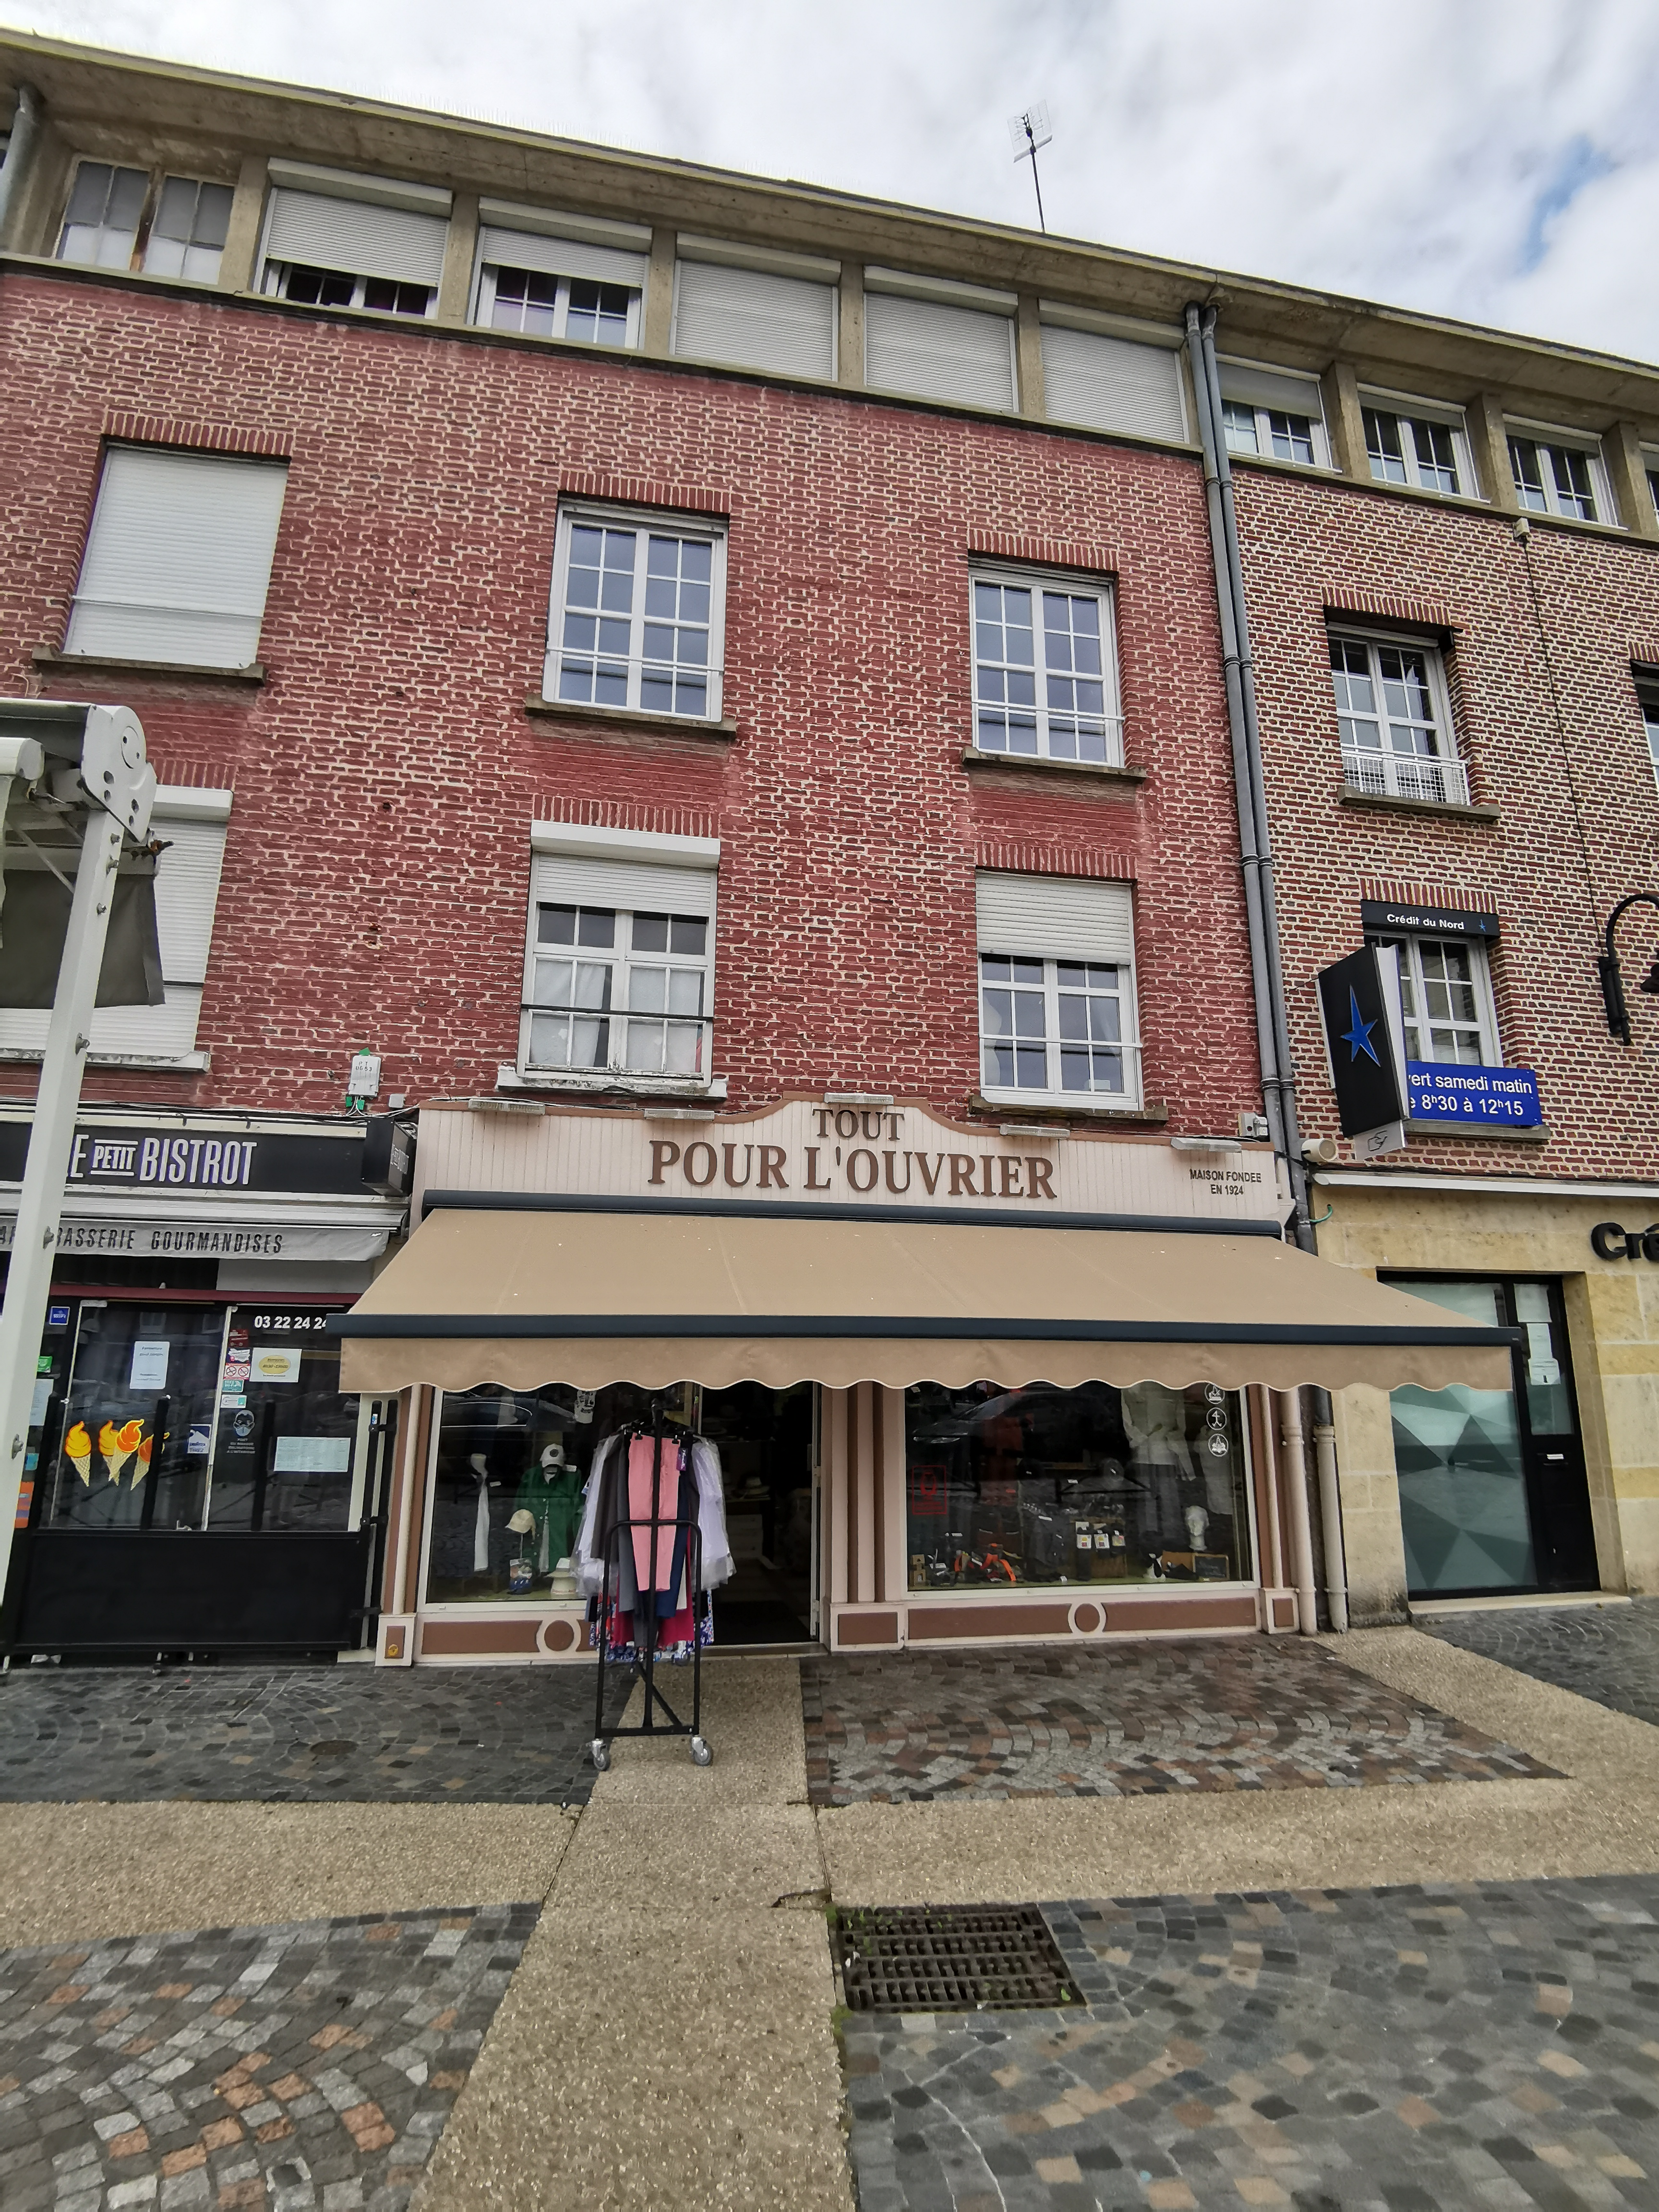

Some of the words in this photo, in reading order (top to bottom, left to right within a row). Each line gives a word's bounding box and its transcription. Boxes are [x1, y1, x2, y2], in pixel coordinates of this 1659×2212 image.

[1387, 914, 1420, 925] Crédit
[1423, 918, 1436, 927] du
[1439, 919, 1465, 930] Nord
[1408, 1072, 1432, 1087] ert
[1435, 1076, 1489, 1091] samedi
[1492, 1079, 1533, 1094] matin
[1421, 1094, 1457, 1112] 8h30
[1463, 1097, 1474, 1113] à
[1479, 1098, 1524, 1116] 12h15
[812, 1108, 905, 1141] TOUT
[70, 1134, 90, 1178] E
[92, 1145, 136, 1170] PETIT
[139, 1137, 257, 1185] BISTROT
[647, 1140, 789, 1188] POUR
[803, 1146, 1058, 1199] L'OUVRIER
[1189, 1168, 1224, 1181] MAISON
[1226, 1171, 1262, 1183] FONDEE
[1210, 1184, 1222, 1195] EN
[1225, 1185, 1244, 1195] 1924
[151, 1231, 283, 1254] GOURMANDISES
[254, 1315, 271, 1328] 03
[274, 1316, 291, 1329] 22
[293, 1316, 311, 1329] 24
